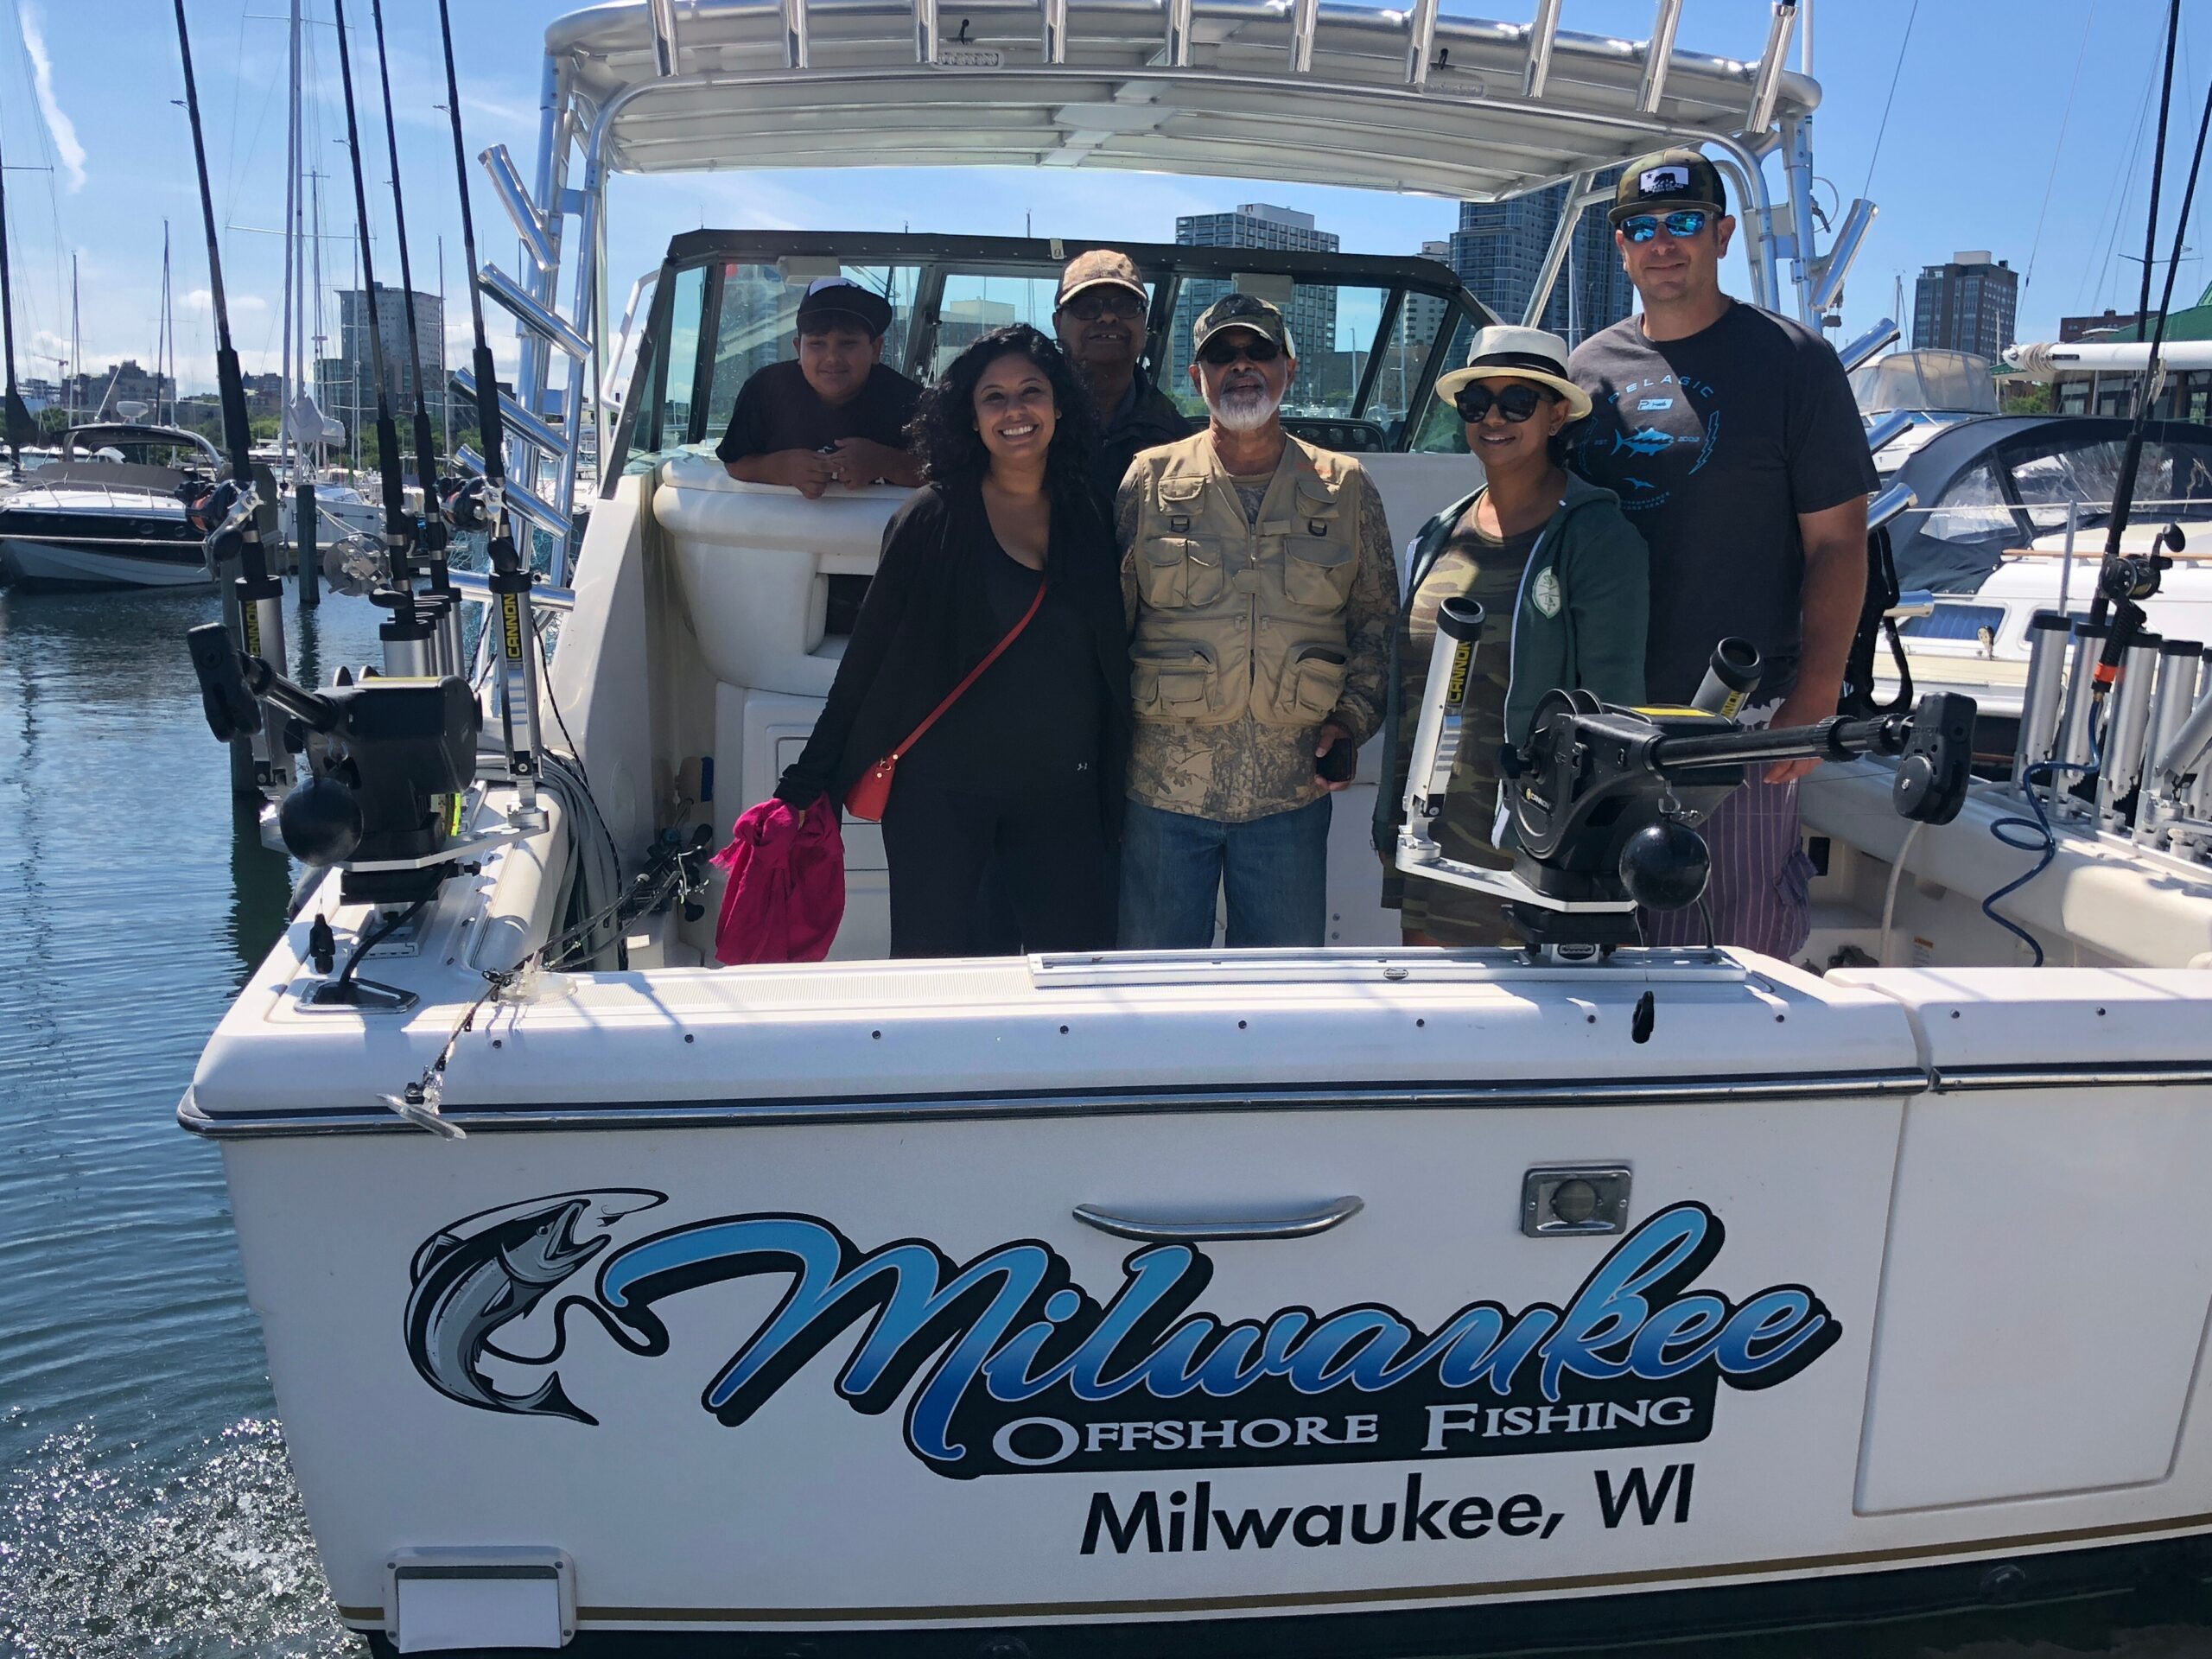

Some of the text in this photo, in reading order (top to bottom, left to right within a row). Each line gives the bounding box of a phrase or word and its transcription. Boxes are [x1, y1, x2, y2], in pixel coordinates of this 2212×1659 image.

[1607, 374, 1714, 404] PELAGIC
[245, 600, 261, 655] ANNON
[503, 593, 520, 658] CANNON
[1446, 640, 1471, 703] CANNON
[598, 1203, 1836, 1469] Milwaukee
[993, 1395, 1694, 1466] OFFSHORE FISHING
[1080, 1463, 1695, 1555] Milwaukee, WI
